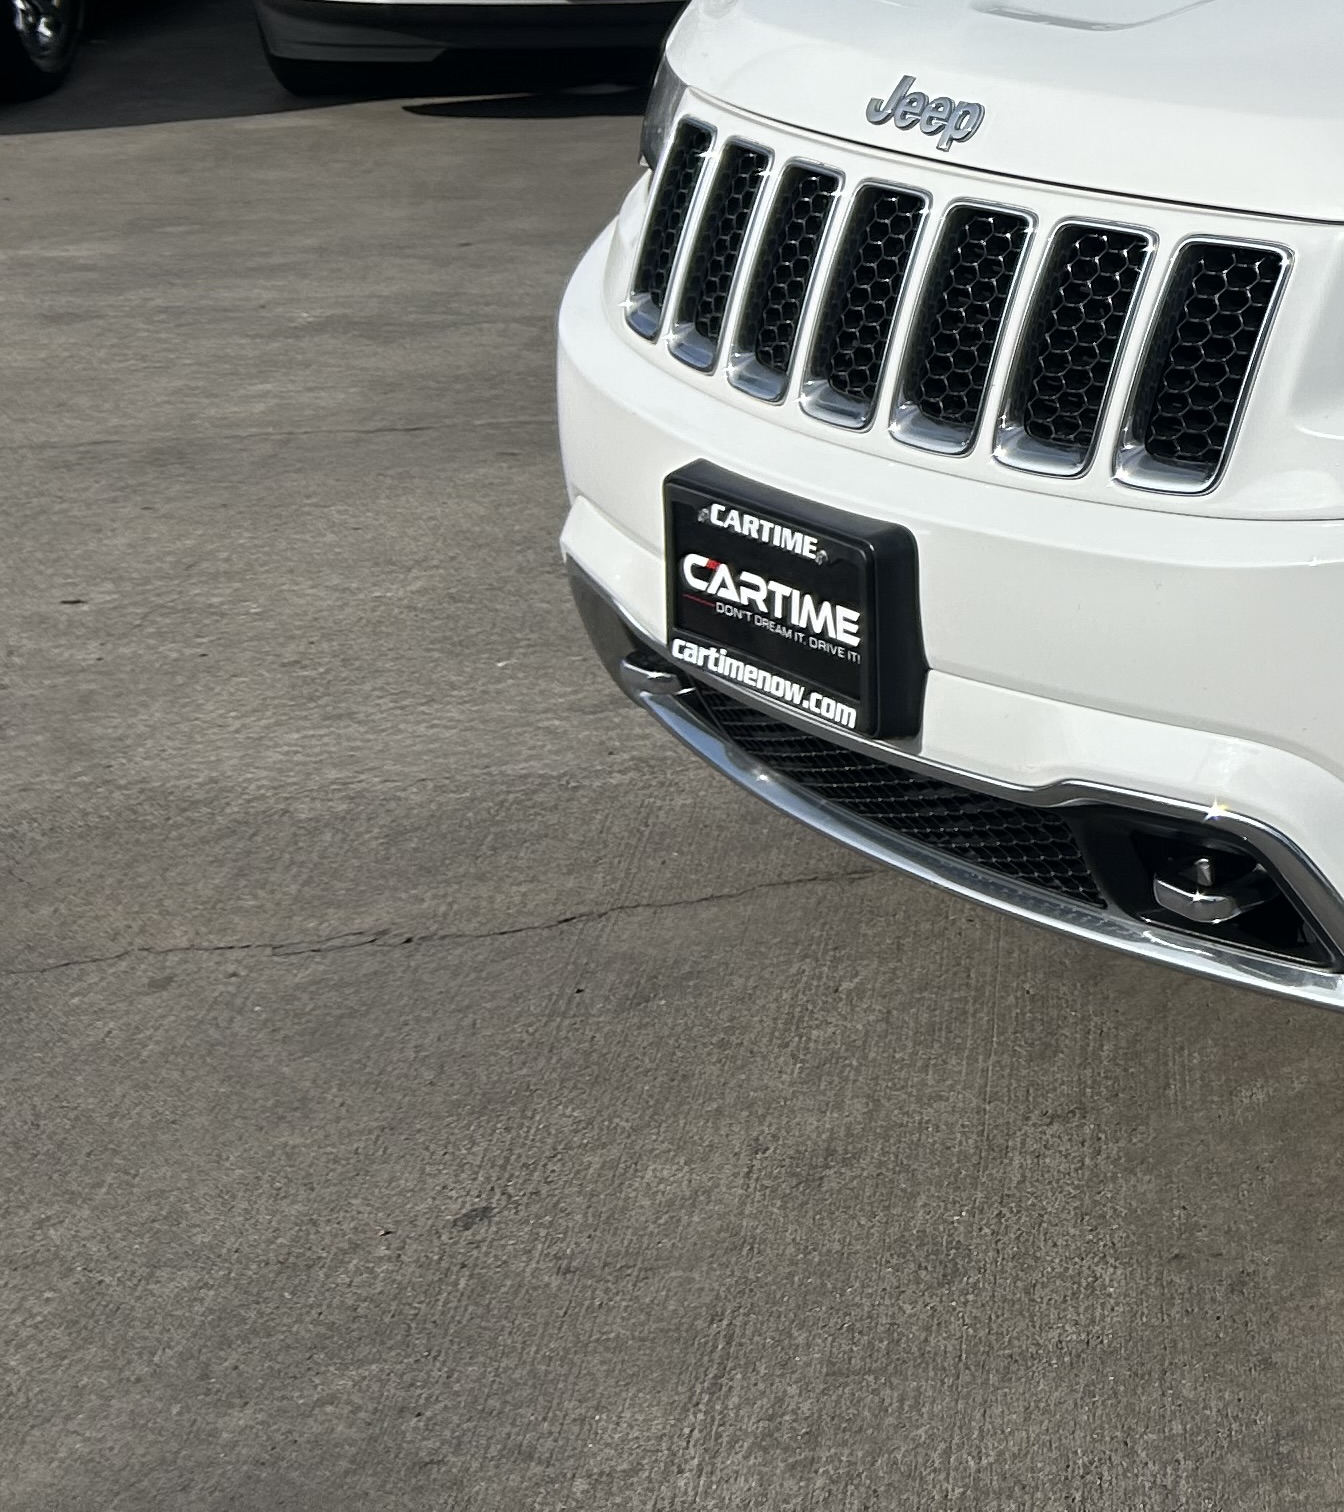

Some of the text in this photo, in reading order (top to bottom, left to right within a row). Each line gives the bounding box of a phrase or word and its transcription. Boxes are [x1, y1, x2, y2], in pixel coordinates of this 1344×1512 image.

[866, 74, 985, 152] Jeep
[708, 503, 818, 560] CARTIME
[681, 552, 861, 648] CARTIME
[716, 601, 862, 665] DON'T DREAM IT. DRIVE IT!
[672, 637, 857, 730] cartimenow.com
